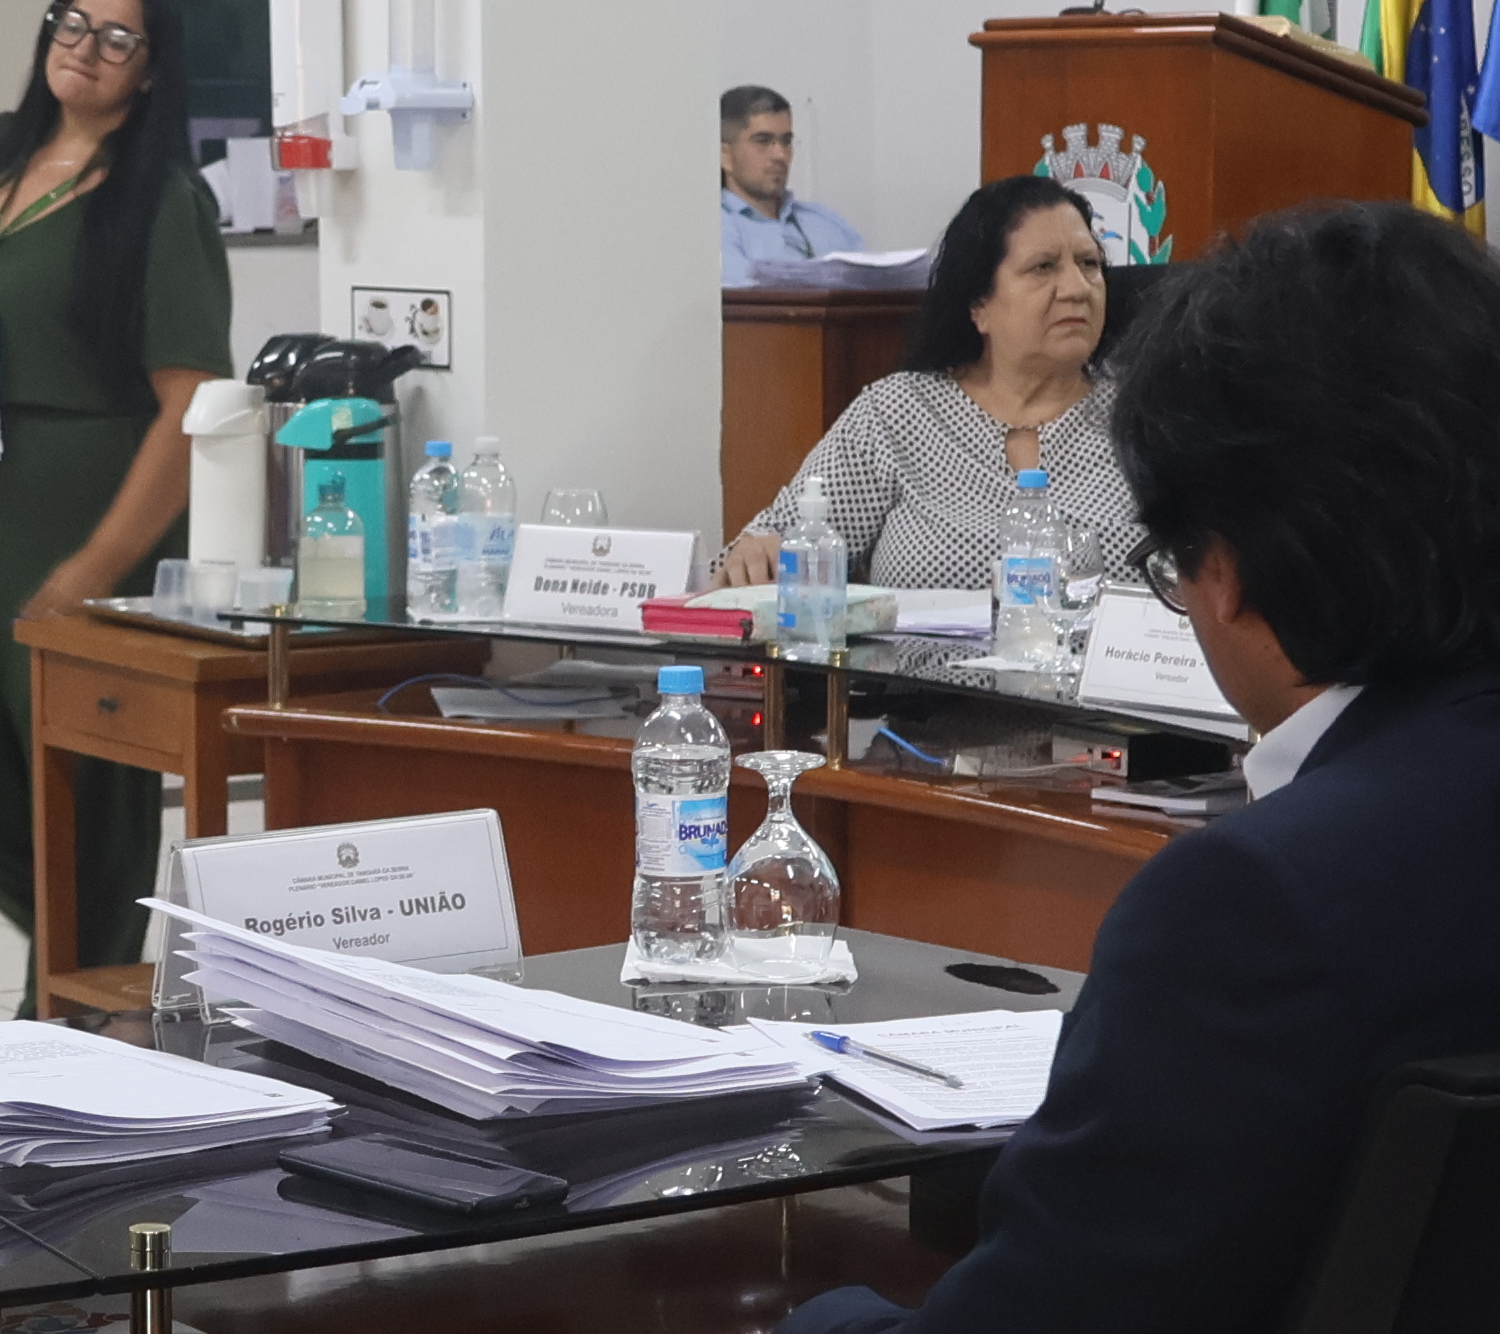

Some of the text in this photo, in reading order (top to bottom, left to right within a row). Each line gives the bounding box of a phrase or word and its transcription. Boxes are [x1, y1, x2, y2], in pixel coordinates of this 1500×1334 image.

[533, 575, 568, 593] Dona
[570, 578, 611, 596] Neide
[619, 581, 657, 599] PSDB
[560, 601, 619, 618] Vereadora
[1104, 645, 1151, 663] Horácio
[1153, 651, 1197, 668] Pereira
[679, 820, 728, 841] BRUNAD
[244, 911, 326, 937] Rogério
[330, 905, 382, 926] Silva
[399, 890, 467, 918] UNIÃO
[332, 932, 391, 950] Vereador
